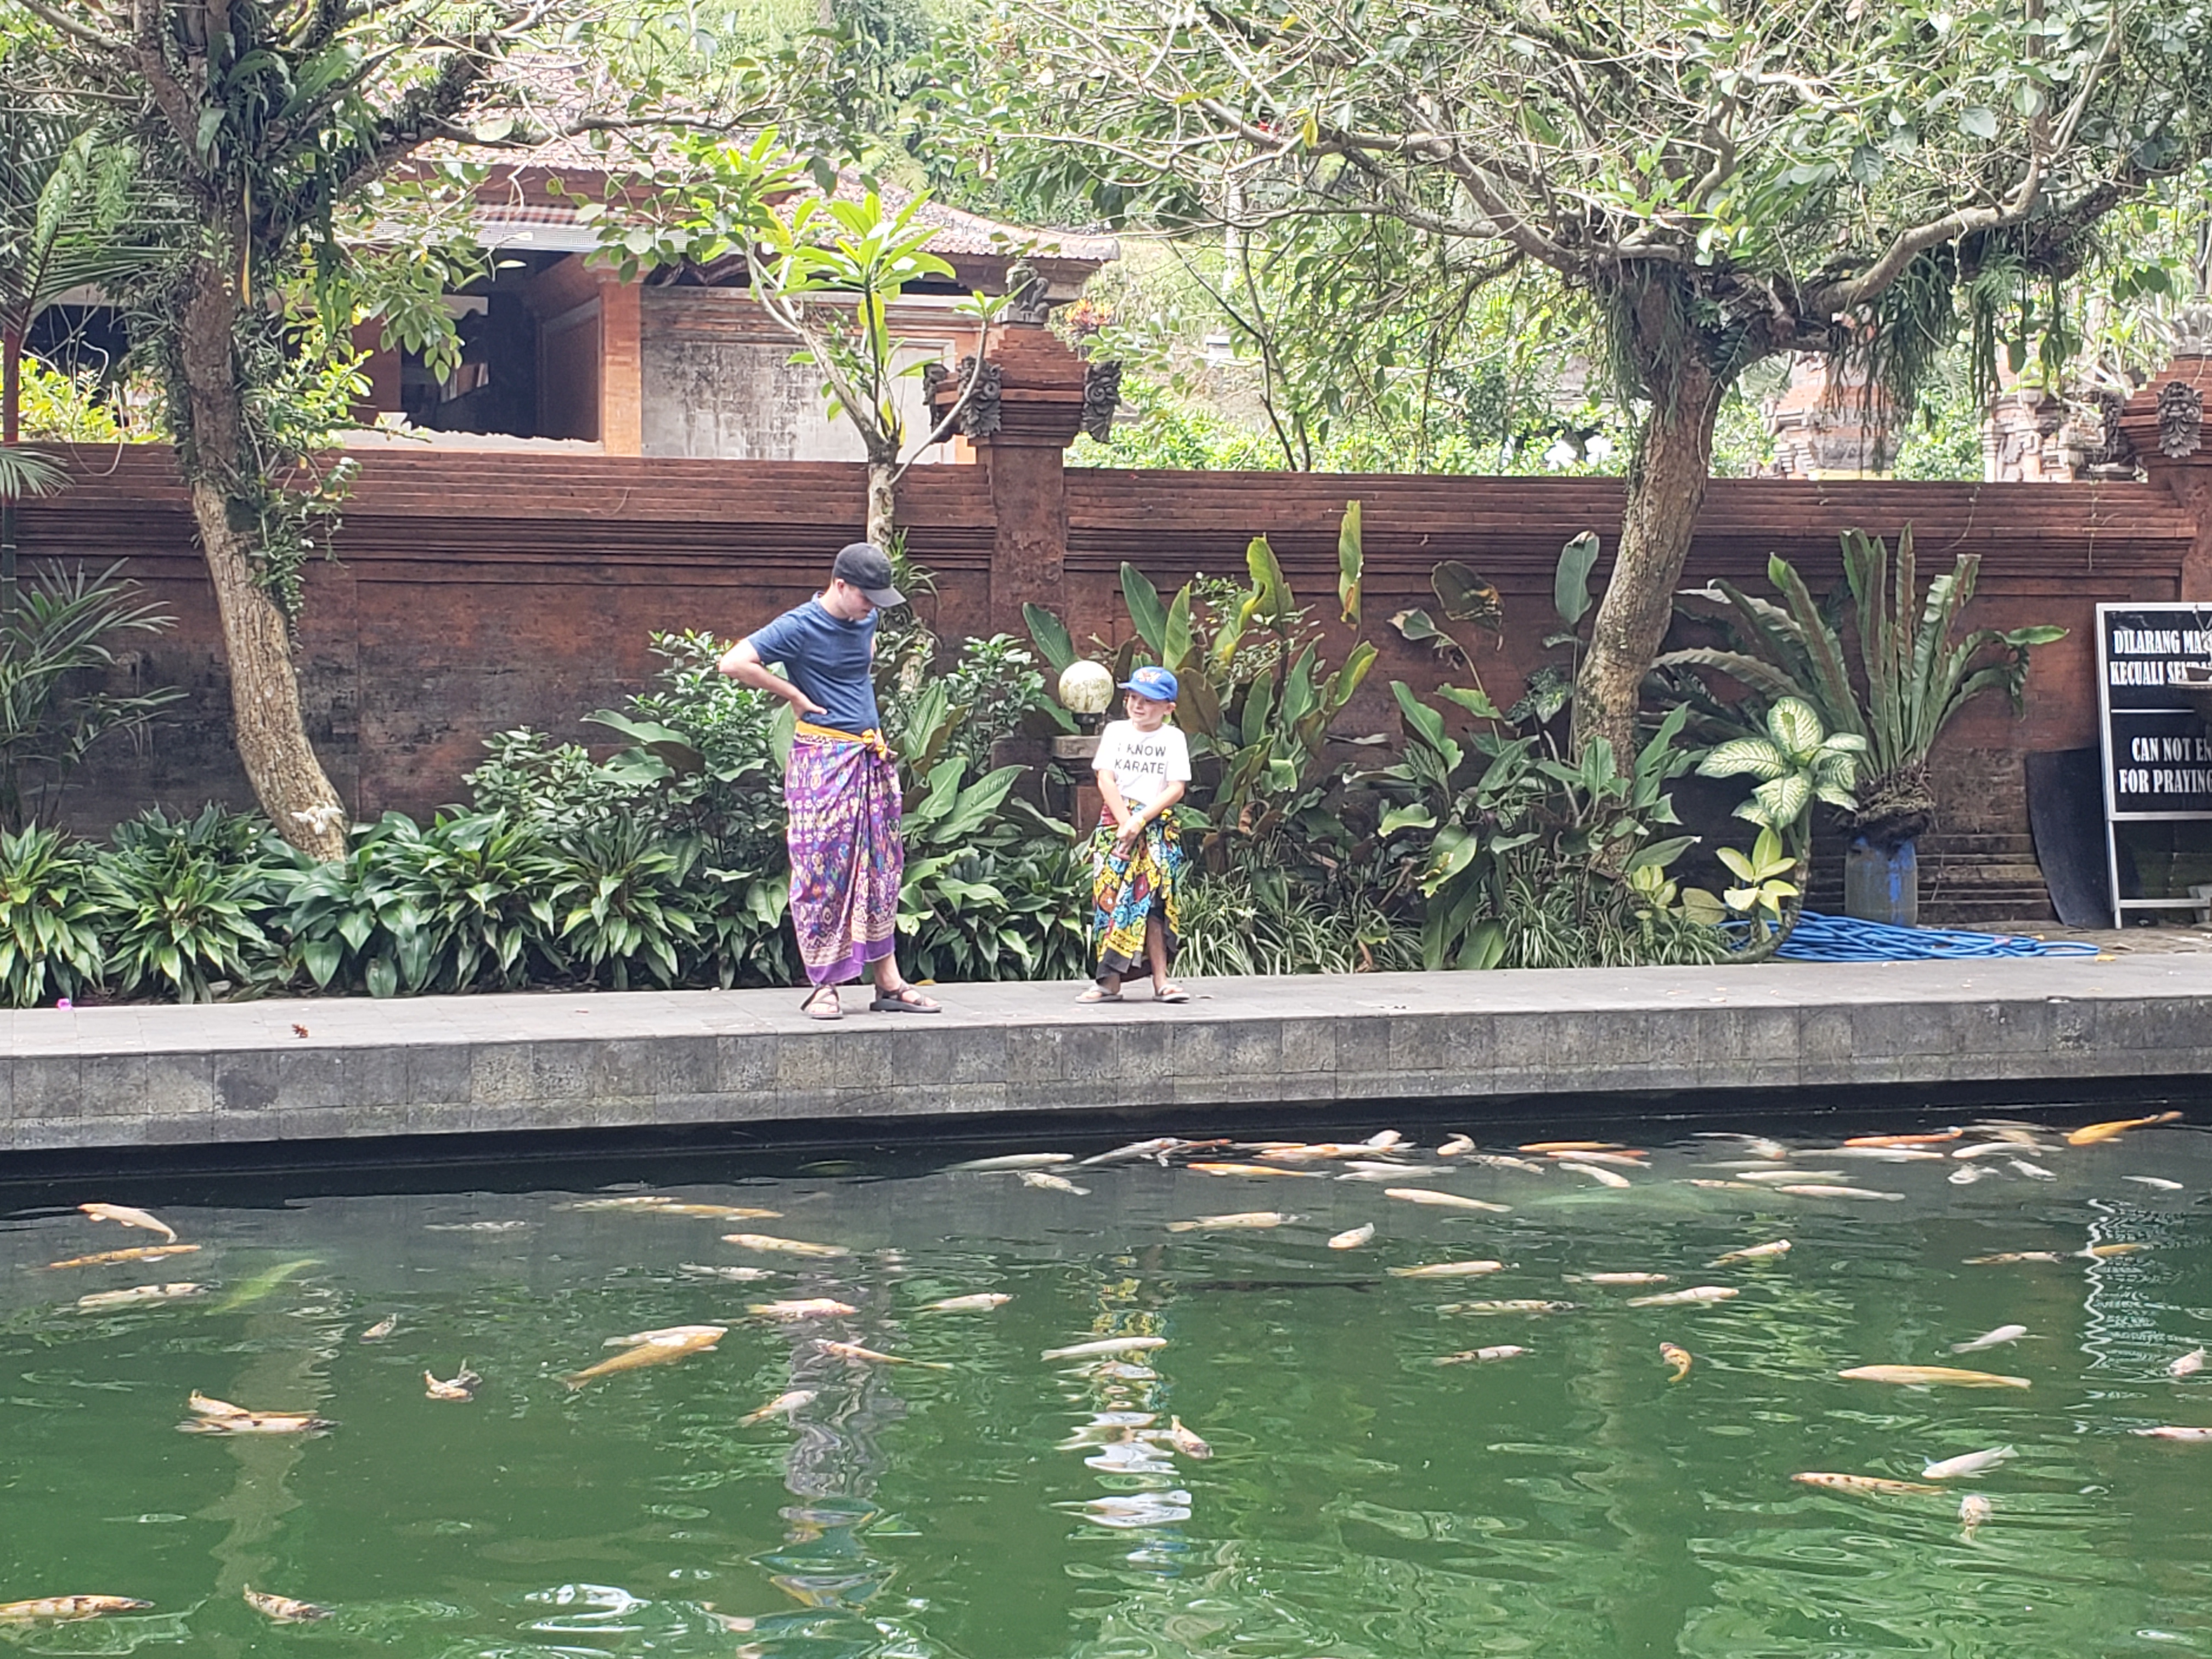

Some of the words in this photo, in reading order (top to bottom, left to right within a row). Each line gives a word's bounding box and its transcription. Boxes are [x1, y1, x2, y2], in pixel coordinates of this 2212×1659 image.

[2113, 630, 2180, 654] DILARANG
[2109, 661, 2164, 685] KECUALI
[1126, 743, 1166, 757] KNOW
[2132, 737, 2159, 762] CAN
[2162, 737, 2191, 762] NOT
[1114, 758, 1165, 775] KARATE
[2119, 769, 2149, 793] FOR
[2152, 769, 2212, 793] PRAYING
